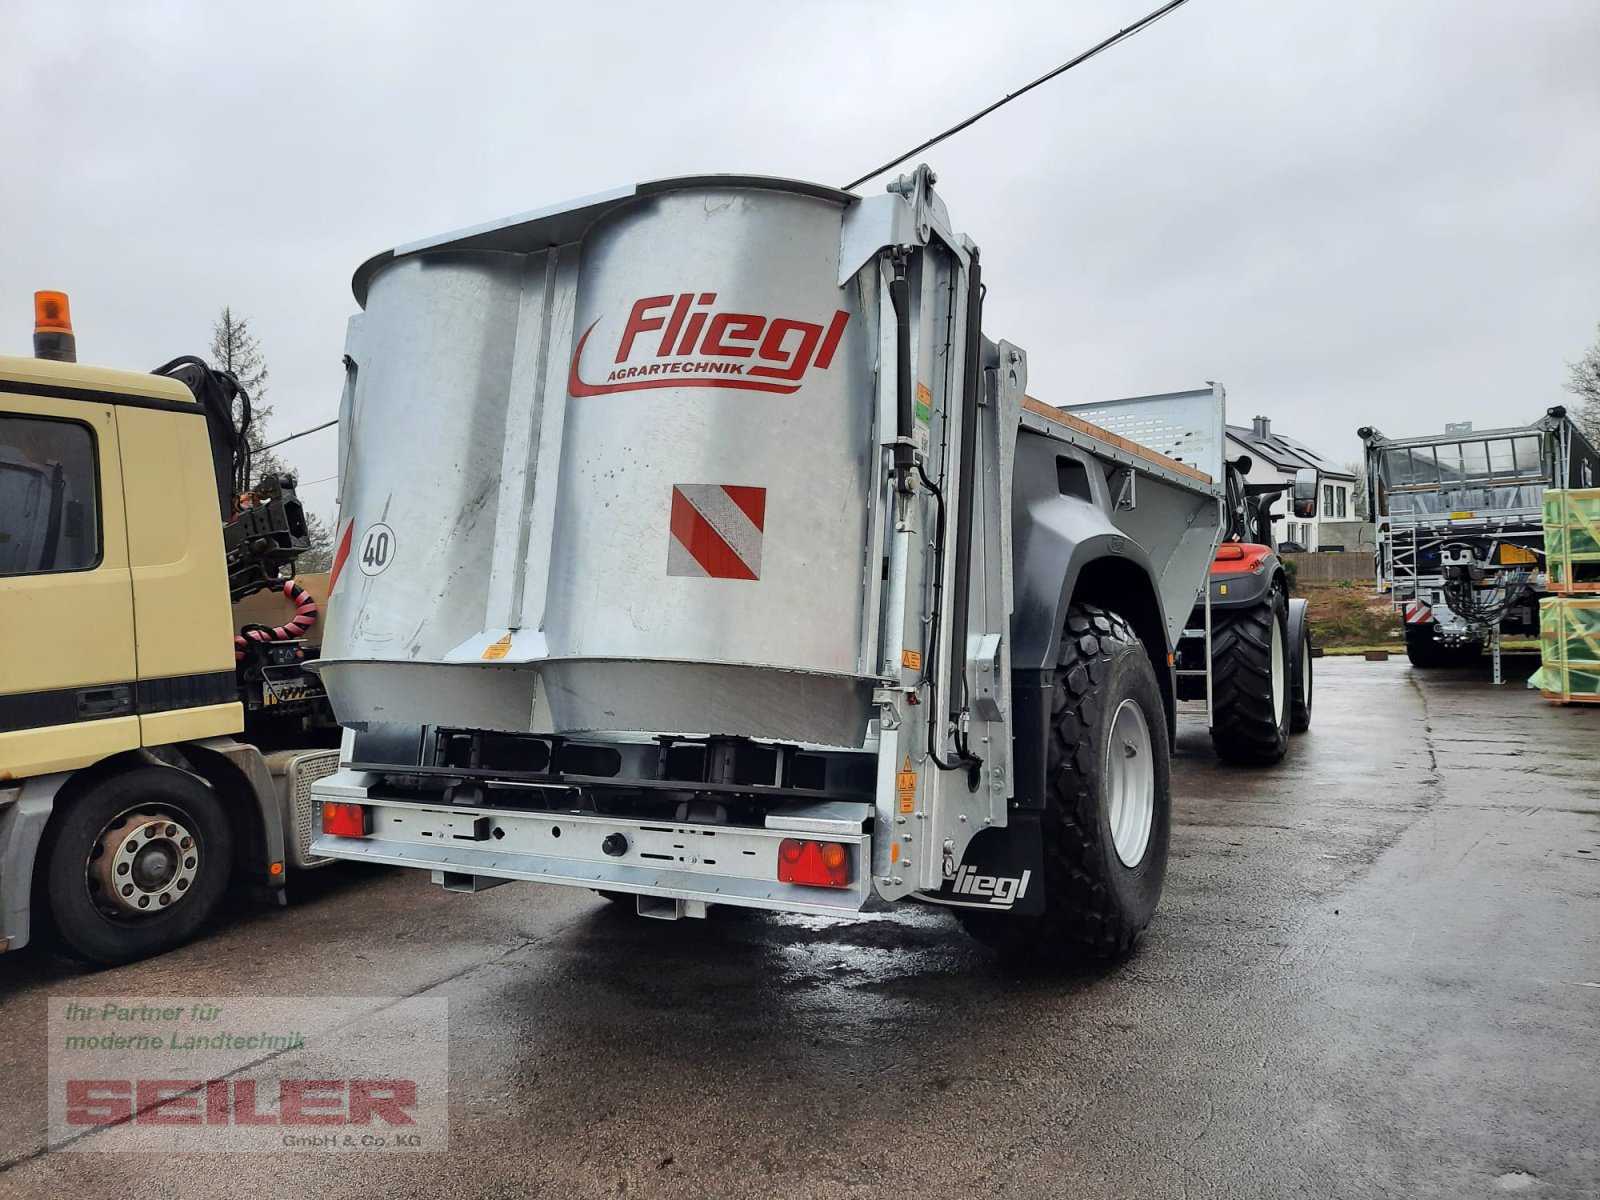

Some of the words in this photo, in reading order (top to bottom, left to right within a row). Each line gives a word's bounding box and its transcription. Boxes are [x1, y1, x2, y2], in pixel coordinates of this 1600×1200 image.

[614, 292, 851, 381] Fliegl
[606, 361, 746, 383] AGRARTECHNIK
[362, 532, 389, 567] 40
[943, 865, 1031, 904] liegl
